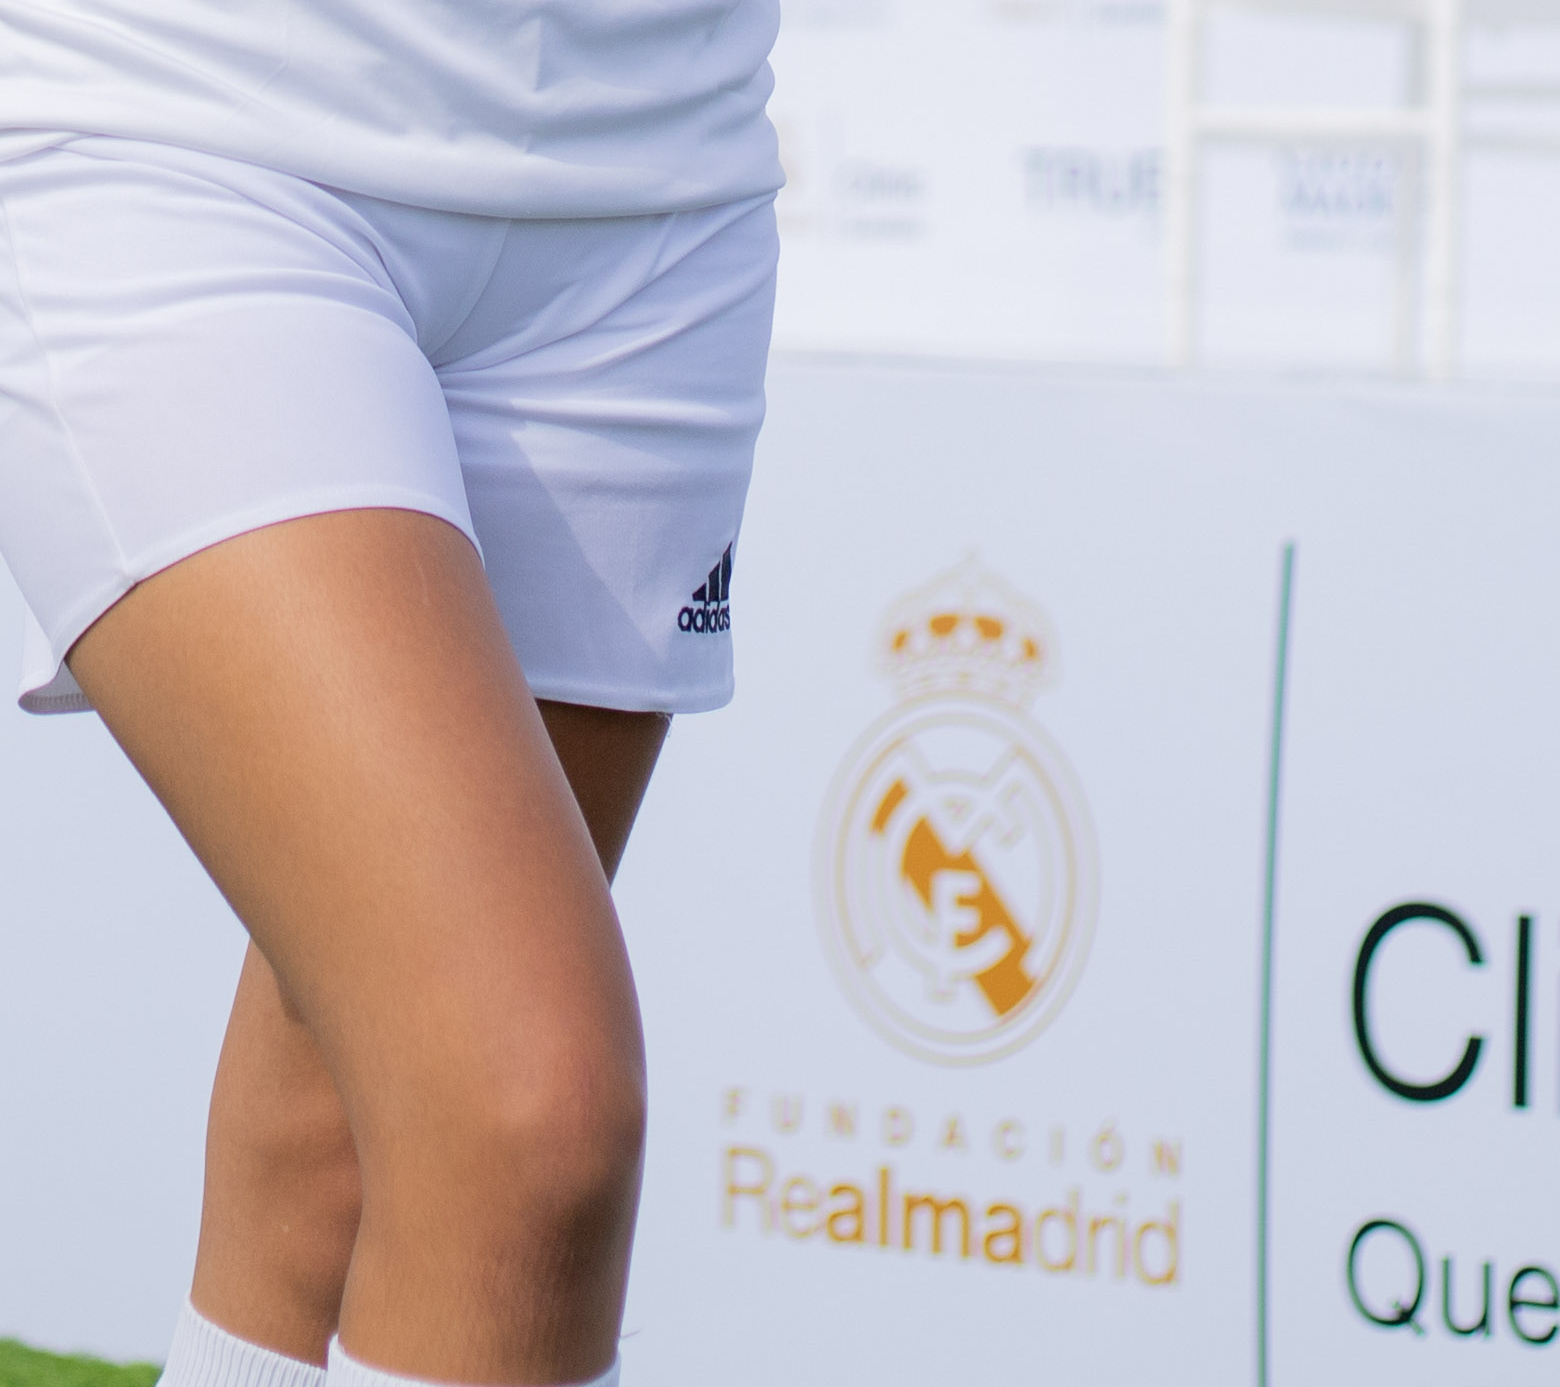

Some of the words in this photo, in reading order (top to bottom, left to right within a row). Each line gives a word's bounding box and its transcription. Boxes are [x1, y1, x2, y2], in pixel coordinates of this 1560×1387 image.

[677, 600, 731, 634] adidas
[724, 1083, 1183, 1179] FUNDACIÓN
[720, 1145, 1183, 1289] Realmadrid
